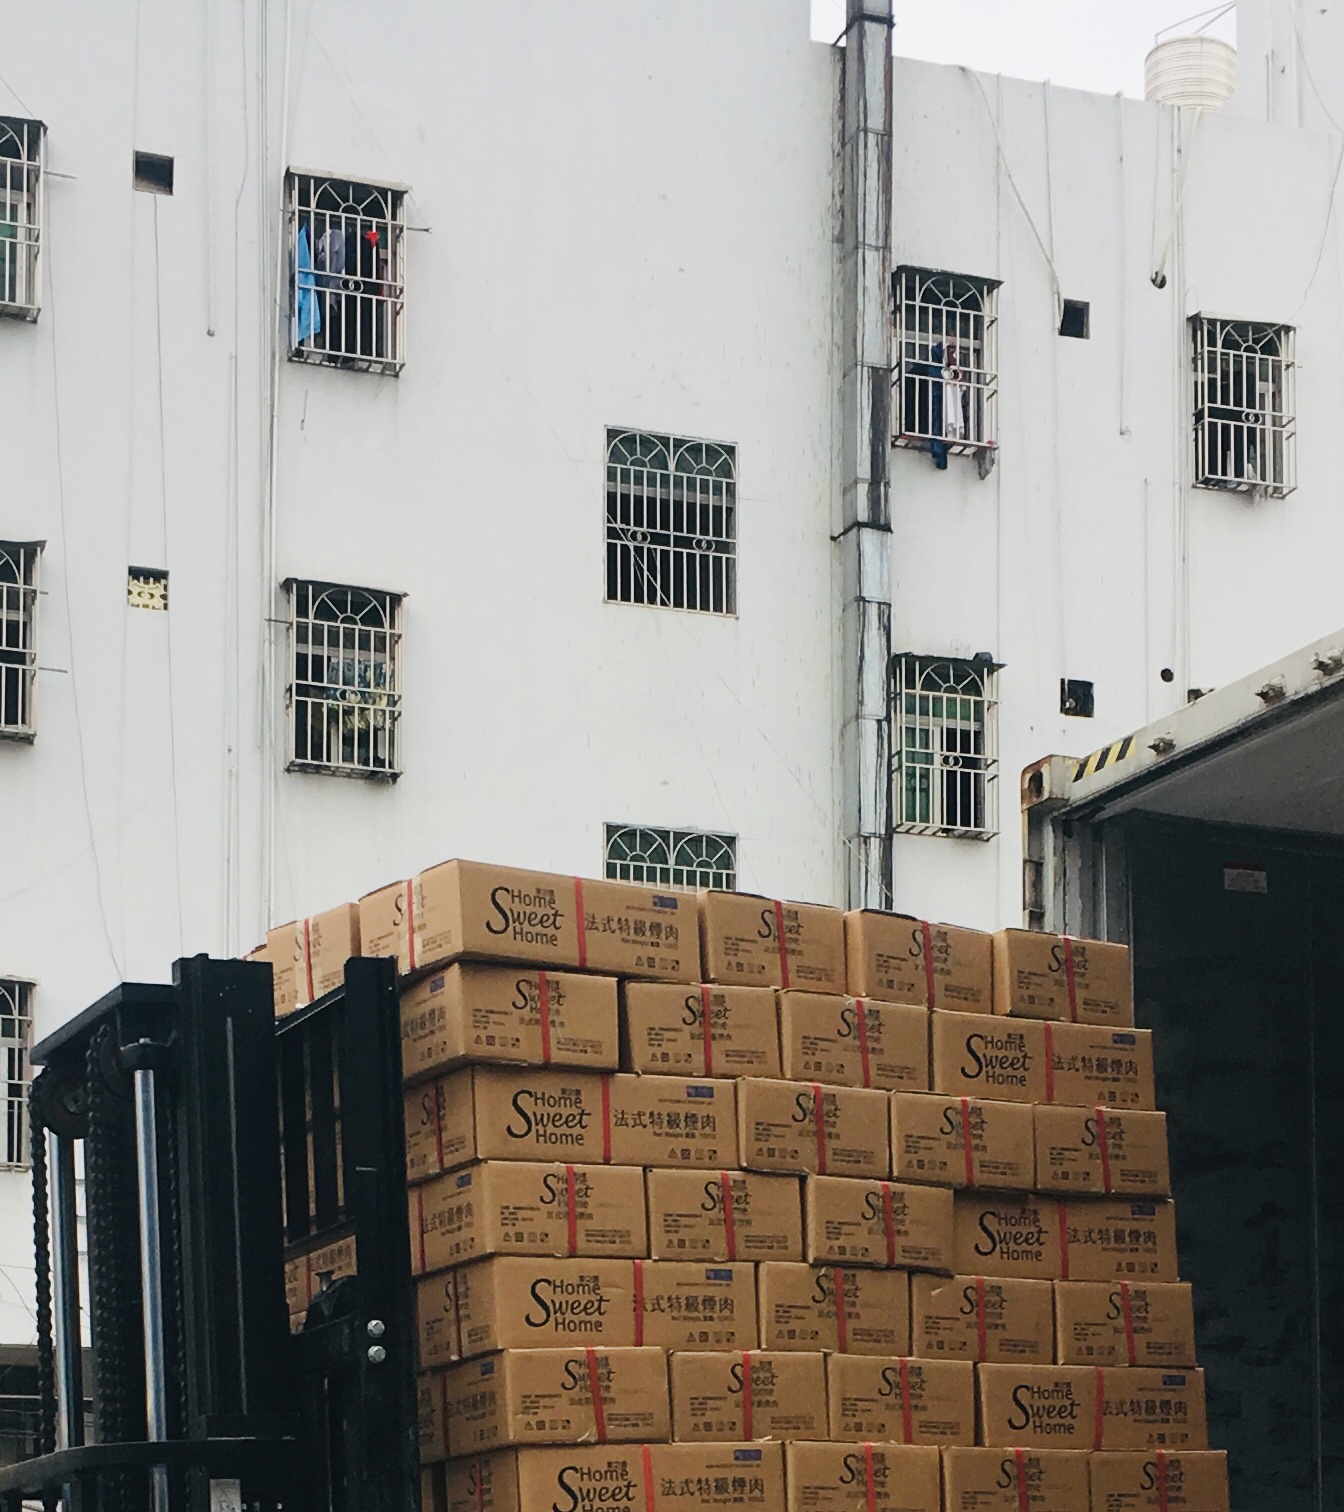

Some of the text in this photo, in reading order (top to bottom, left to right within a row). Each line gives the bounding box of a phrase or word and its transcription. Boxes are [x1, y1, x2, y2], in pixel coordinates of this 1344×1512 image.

[511, 888, 556, 909] Home
[486, 886, 564, 935] Sweet
[513, 926, 558, 946] Home
[985, 1035, 1026, 1053] Home
[961, 1033, 1032, 1079] Sweet
[986, 1070, 1027, 1087] Home
[534, 1091, 582, 1109] Home
[507, 1089, 591, 1138] Sweet
[535, 1128, 584, 1145] Home
[997, 1211, 1040, 1227] Home
[974, 1210, 1049, 1256] Sweet
[1000, 1247, 1042, 1262] Home
[552, 1279, 601, 1296] Home
[525, 1278, 610, 1327] Sweet
[555, 1317, 603, 1333] Home
[1031, 1385, 1073, 1400] Home
[1008, 1384, 1080, 1430] Sweet
[1033, 1420, 1075, 1434] Home
[580, 1467, 629, 1482] Home
